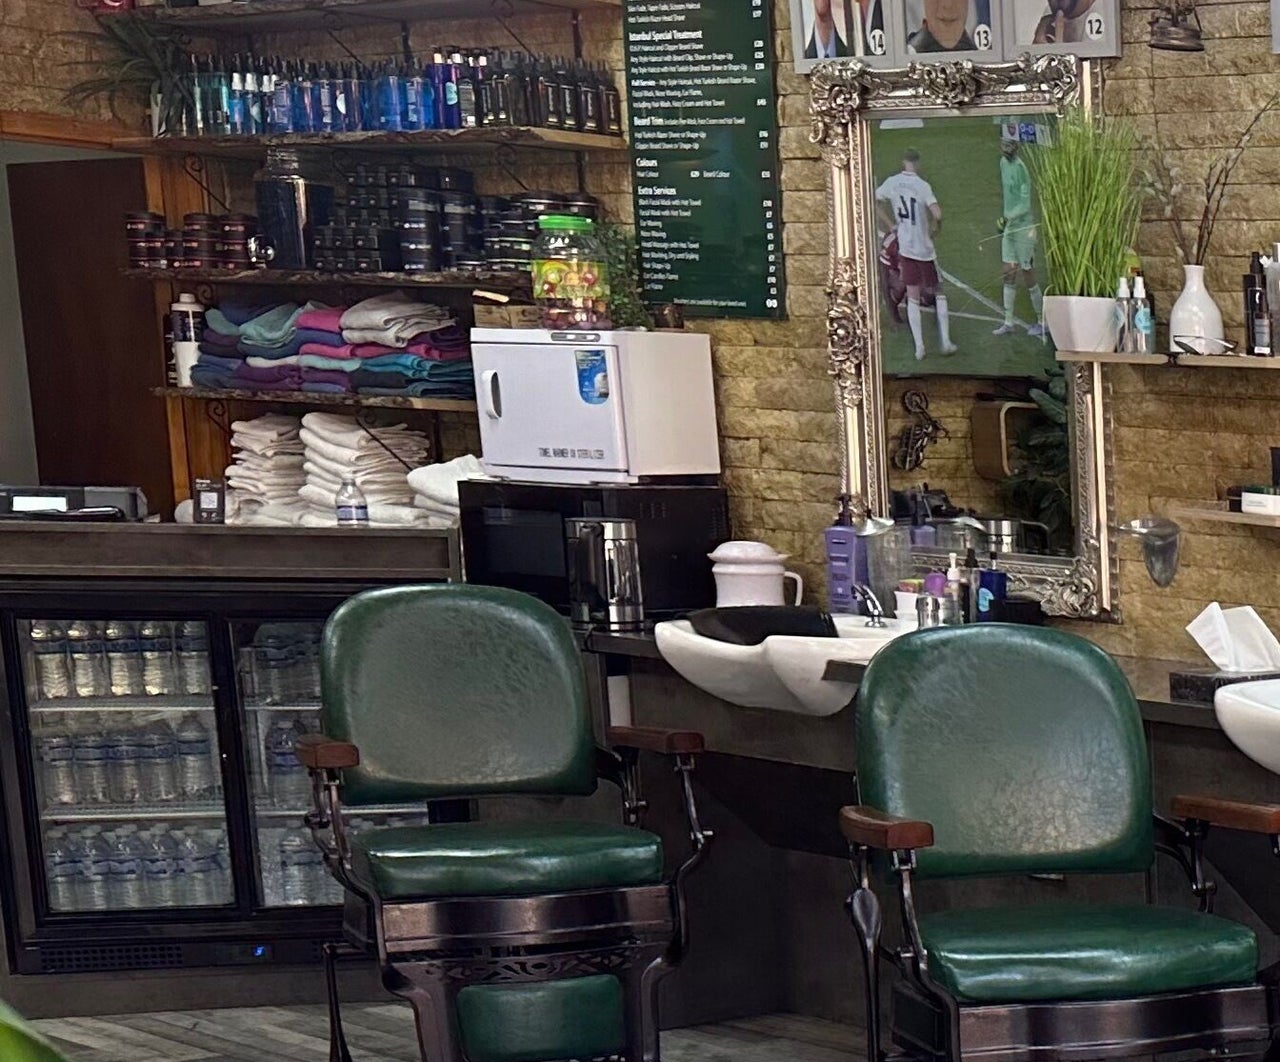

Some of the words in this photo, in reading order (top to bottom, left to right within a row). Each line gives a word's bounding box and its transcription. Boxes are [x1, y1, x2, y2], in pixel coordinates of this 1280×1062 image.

[652, 31, 672, 41] Special
[673, 30, 702, 39] Treatment
[1087, 19, 1103, 35] 12
[871, 34, 885, 52] 14
[976, 30, 990, 48] 13
